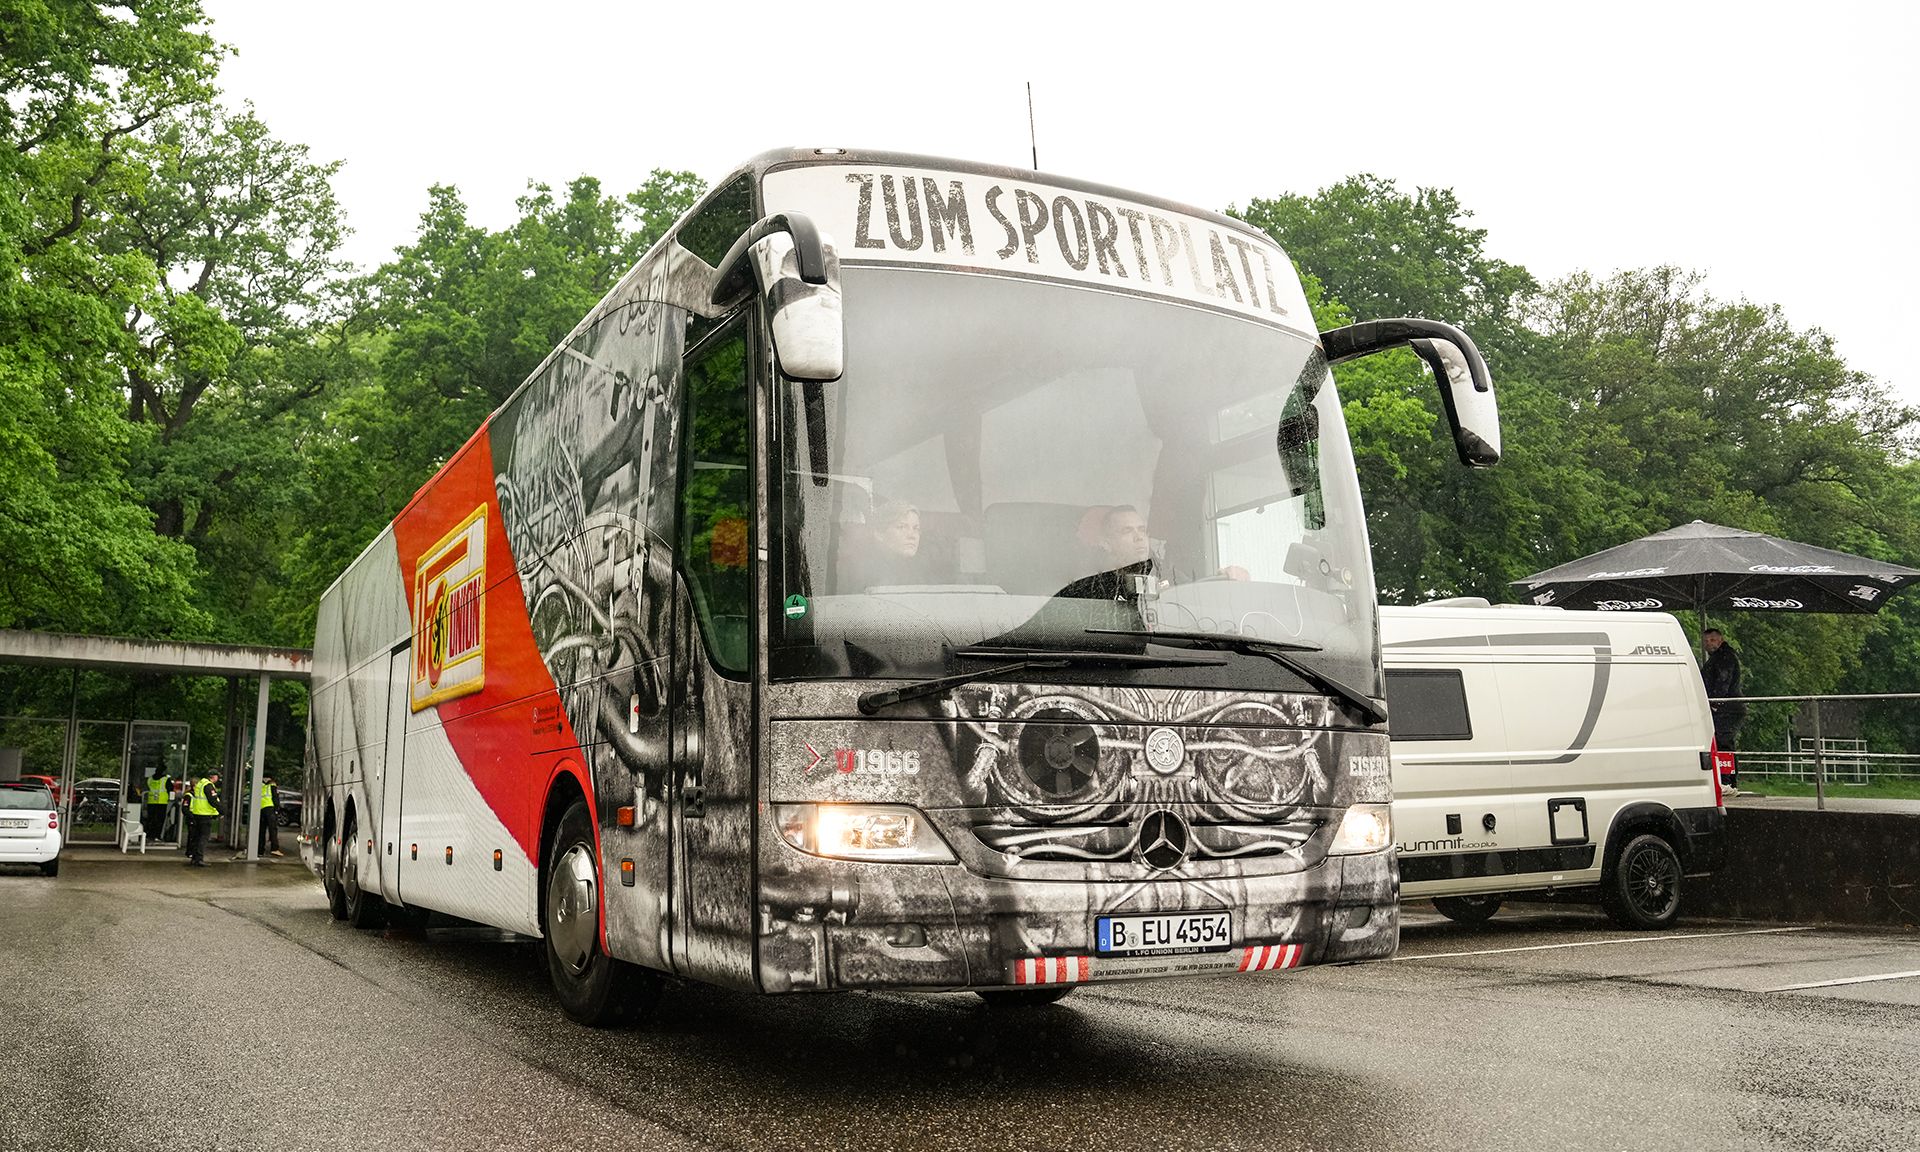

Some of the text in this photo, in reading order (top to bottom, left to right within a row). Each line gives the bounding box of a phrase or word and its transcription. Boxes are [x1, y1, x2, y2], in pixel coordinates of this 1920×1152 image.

[845, 173, 1289, 316] ZUM SPORTPLATZ
[792, 595, 800, 607] 4
[449, 576, 481, 658] UNION
[1636, 643, 1676, 655] PÖSSL
[1481, 841, 1498, 849] plus
[1113, 922, 1127, 947] B
[1142, 920, 1171, 945] EU
[1176, 917, 1228, 943] 4554
[1174, 946, 1199, 954] BERLIN
